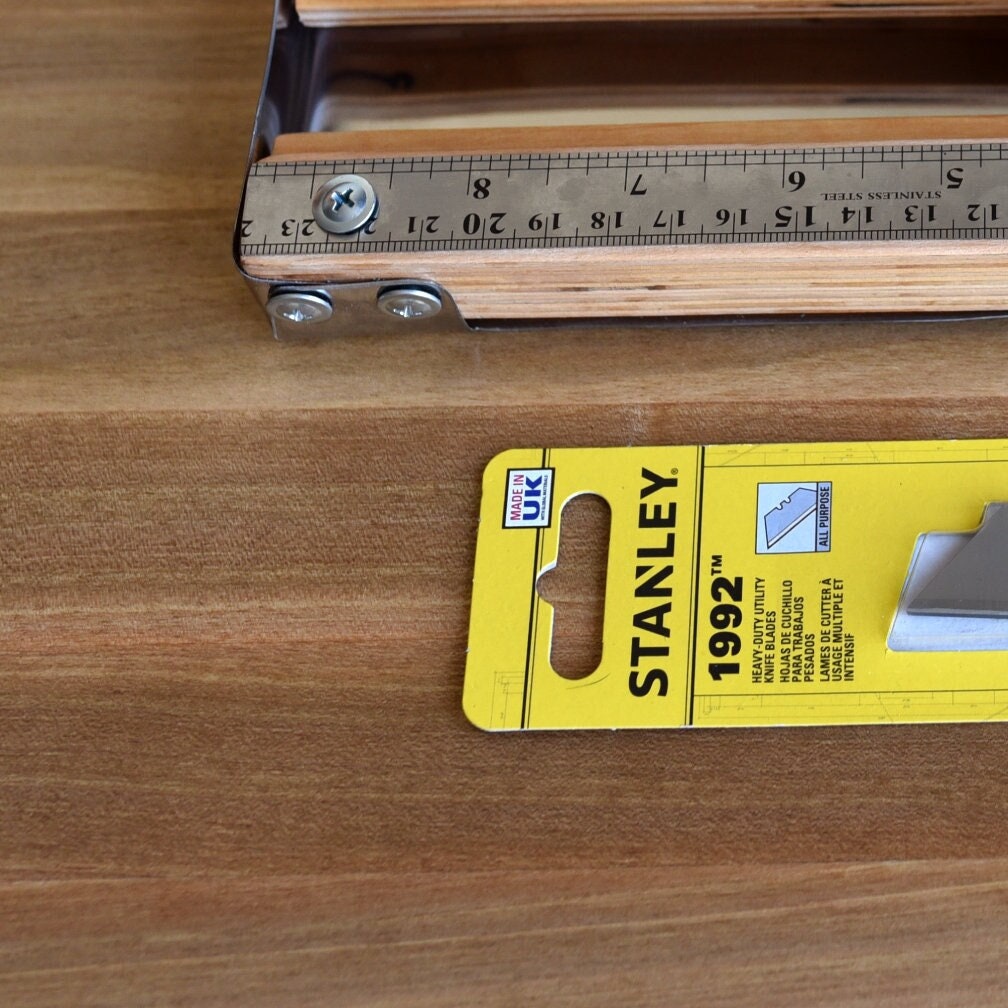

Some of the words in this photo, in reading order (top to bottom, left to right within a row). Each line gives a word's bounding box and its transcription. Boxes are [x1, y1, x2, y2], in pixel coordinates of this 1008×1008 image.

[472, 177, 492, 200] 8
[629, 174, 648, 196] 7
[787, 170, 806, 192] 6
[946, 167, 964, 189] 5
[820, 192, 863, 201] STEEL
[867, 191, 942, 201] STAINLESS
[528, 212, 562, 231] 19
[591, 210, 624, 230] 18
[652, 209, 686, 228] 17
[715, 207, 748, 227] 16
[774, 205, 817, 227] 15
[841, 206, 874, 224] 14
[904, 204, 937, 222] 13
[966, 203, 1000, 221] 12
[281, 218, 315, 237] 23
[407, 215, 441, 234] 21
[462, 212, 507, 235] 20
[513, 474, 524, 486] IN
[510, 489, 523, 521] MADE
[523, 475, 542, 520] UK
[819, 486, 830, 530] PURPOSE
[819, 531, 830, 547] ALL
[754, 577, 765, 614] UTILITY
[834, 579, 843, 590] ET
[781, 580, 792, 628] CUCHILLO
[821, 588, 831, 626] CUTTER
[793, 597, 803, 650] TRABAJOS
[833, 593, 843, 643] MULTIPLE
[765, 611, 776, 650] BLADES
[781, 632, 791, 644] DE
[821, 630, 830, 642] DE
[752, 618, 764, 683] HEAVY-DUTY
[804, 634, 815, 682] PESADOS
[845, 633, 854, 681] INTENSIF
[764, 654, 774, 683] KNIFE
[780, 648, 790, 683] HOJAS
[792, 654, 802, 682] PARA
[820, 646, 830, 682] LAMES
[832, 646, 842, 681] USAGE
